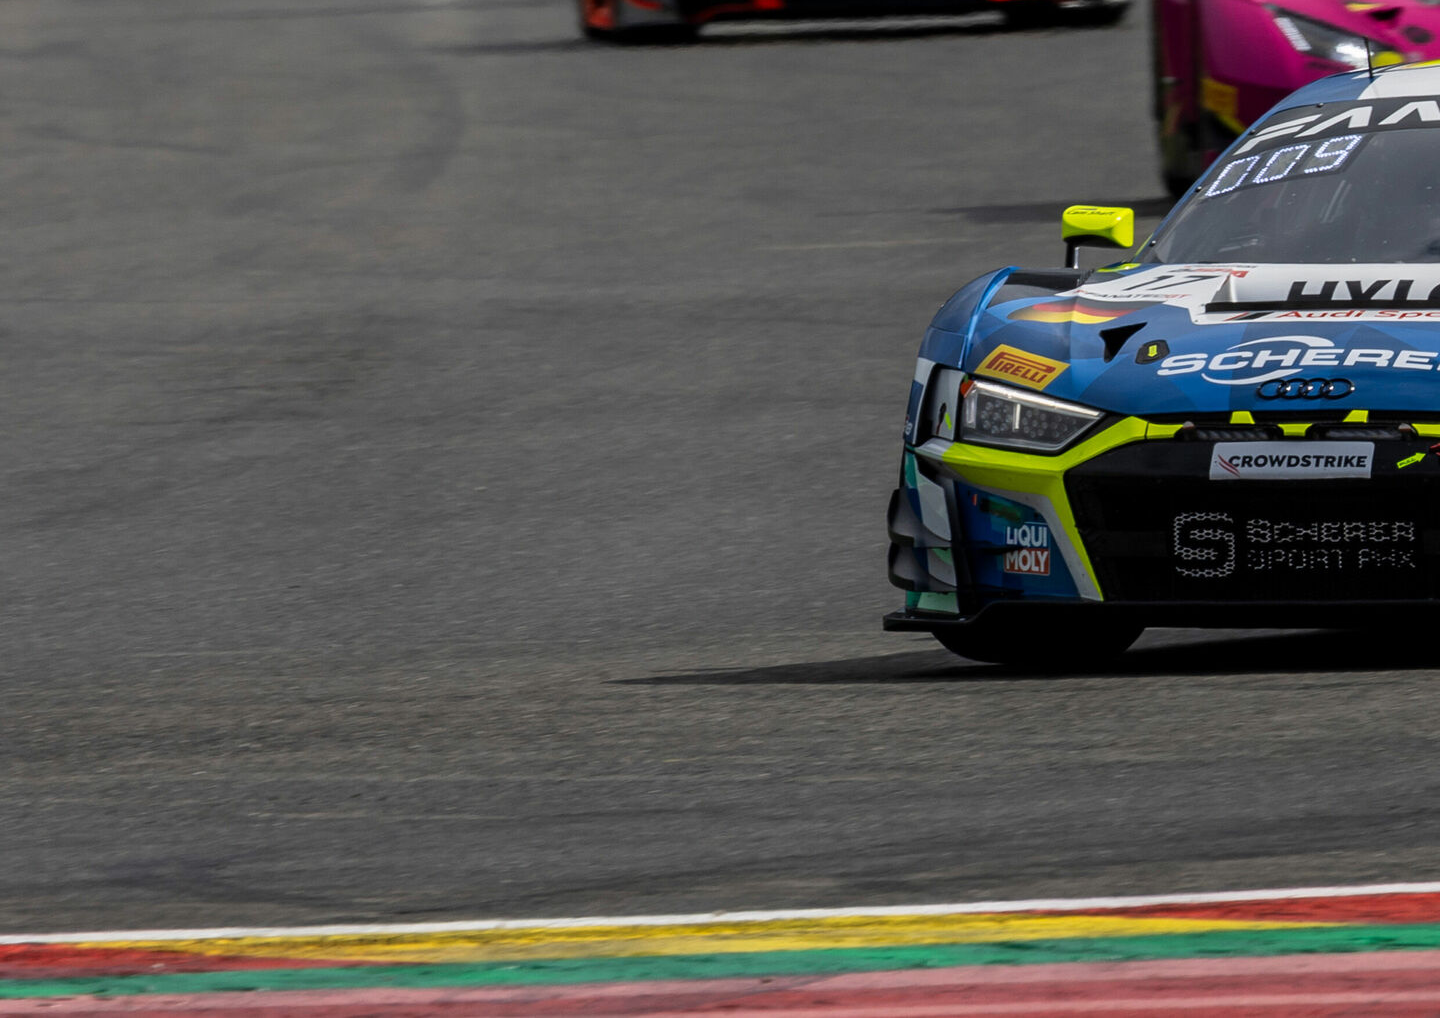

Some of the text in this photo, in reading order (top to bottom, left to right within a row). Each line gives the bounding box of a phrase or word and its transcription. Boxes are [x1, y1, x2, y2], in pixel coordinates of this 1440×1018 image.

[1205, 134, 1363, 197] 009
[1122, 275, 1221, 291] 17
[1276, 310, 1364, 319] Audi
[985, 351, 1057, 384] PIRELLI
[1228, 454, 1367, 469] CROWDSTRIKE
[1006, 525, 1048, 547] LIQUI
[1246, 519, 1415, 543] SCHERER
[1005, 550, 1050, 572] MOLY
